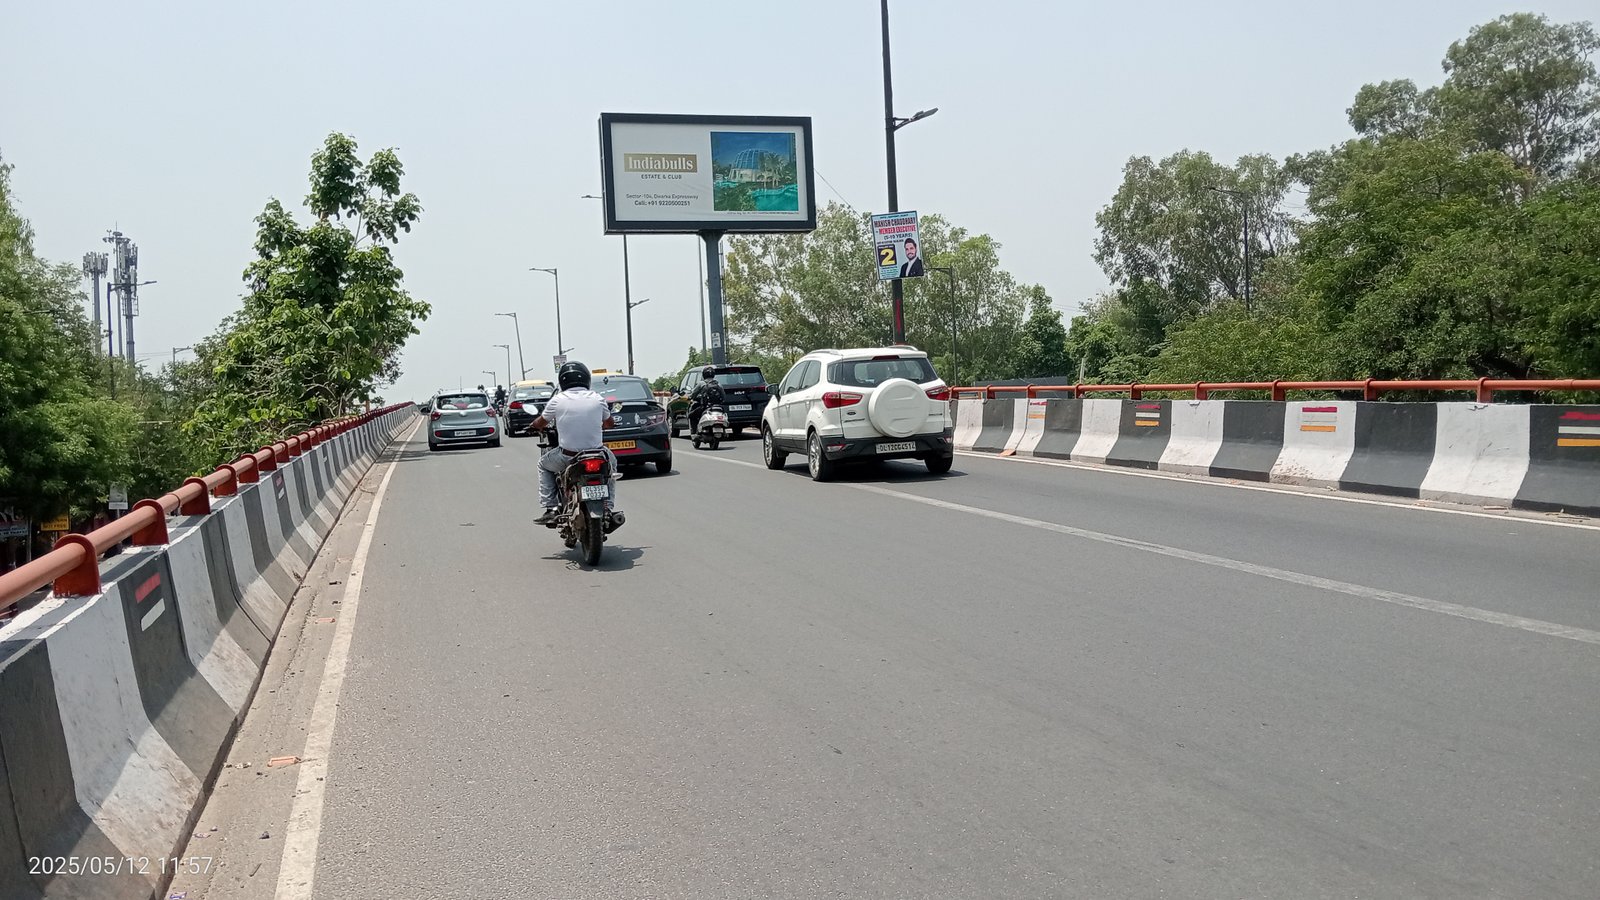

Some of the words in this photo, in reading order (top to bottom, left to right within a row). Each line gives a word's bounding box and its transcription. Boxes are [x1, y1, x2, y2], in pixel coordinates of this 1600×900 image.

[628, 156, 693, 170] Indiabulls
[874, 219, 891, 228] MANISH
[896, 225, 916, 233] EXECUTIVE
[880, 248, 896, 266] 2
